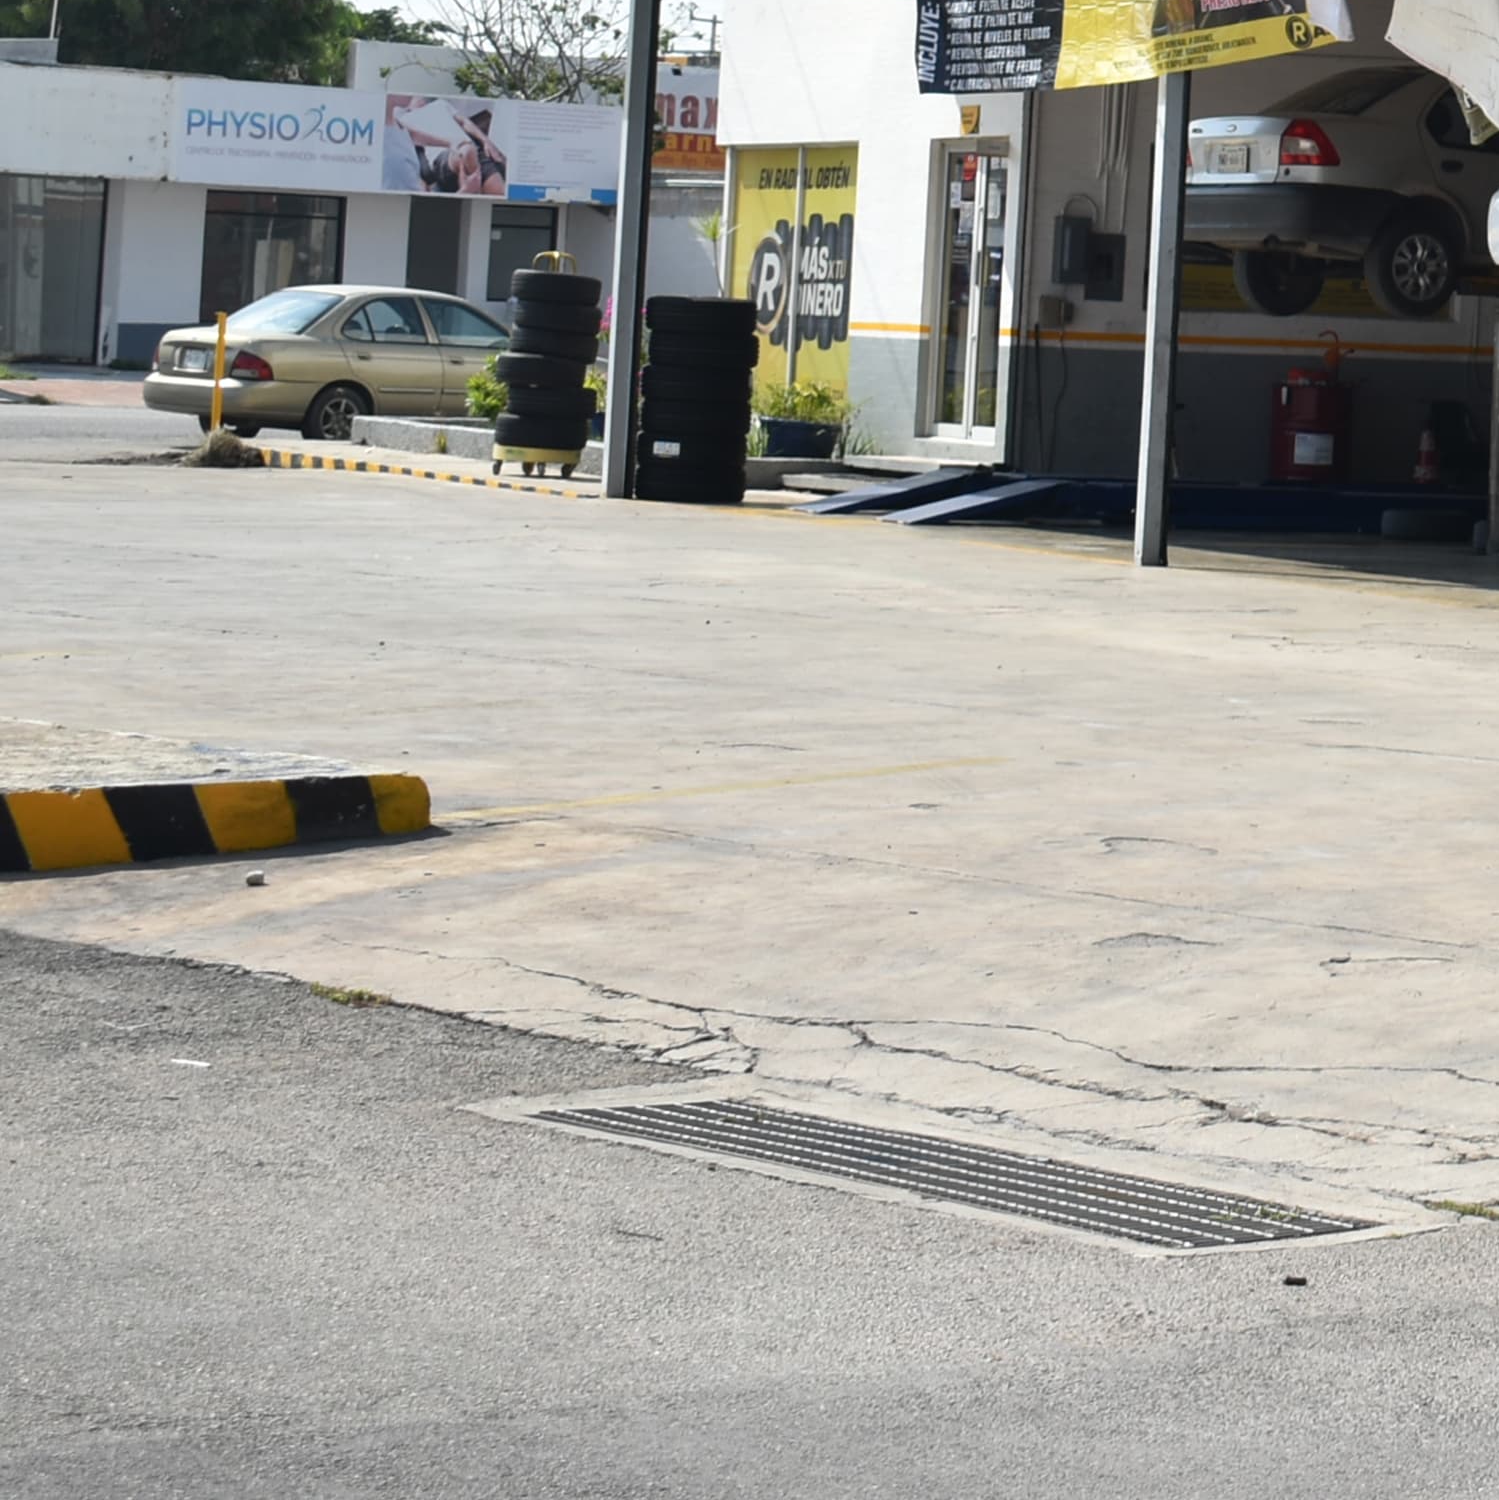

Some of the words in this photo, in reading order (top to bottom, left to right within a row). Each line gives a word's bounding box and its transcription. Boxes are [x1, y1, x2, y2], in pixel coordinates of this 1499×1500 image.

[918, 1, 940, 83] INCLUYE:
[759, 168, 773, 189] EN
[816, 161, 850, 189] OBTÉN
[796, 283, 844, 317] INERO
